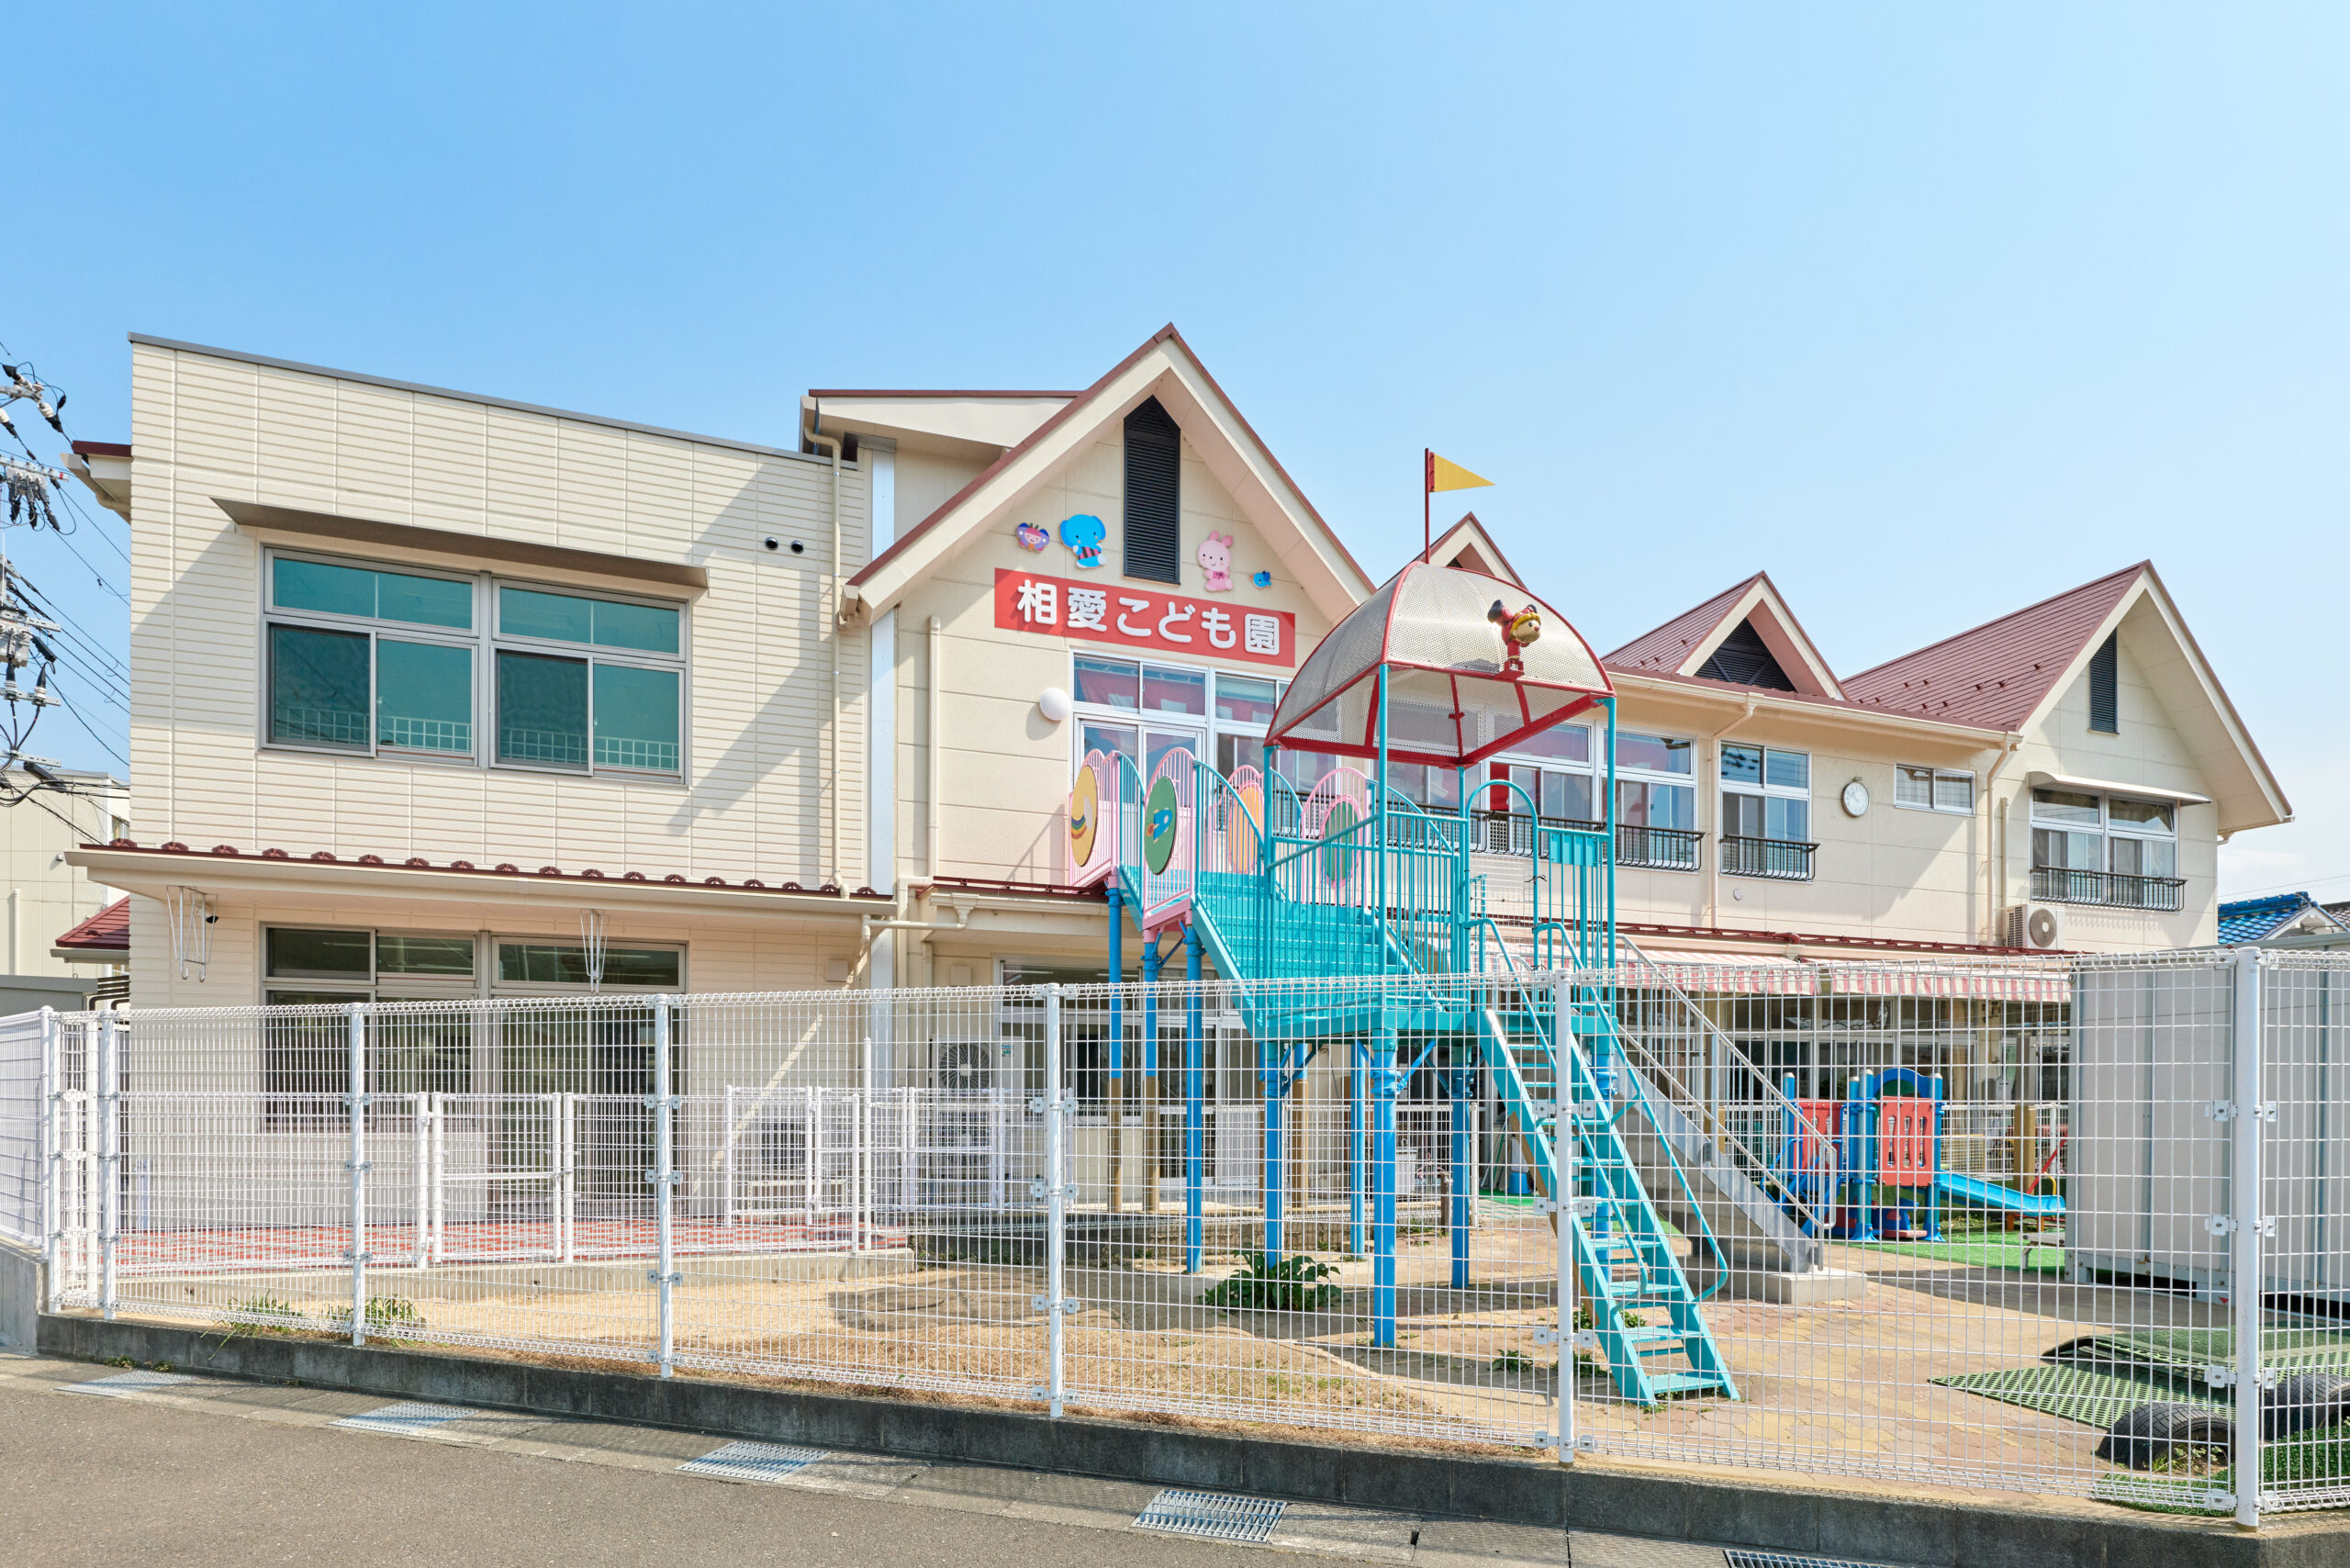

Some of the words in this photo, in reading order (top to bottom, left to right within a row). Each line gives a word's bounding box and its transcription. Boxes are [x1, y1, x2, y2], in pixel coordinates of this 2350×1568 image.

[1017, 579, 1280, 655] 相愛こども園
